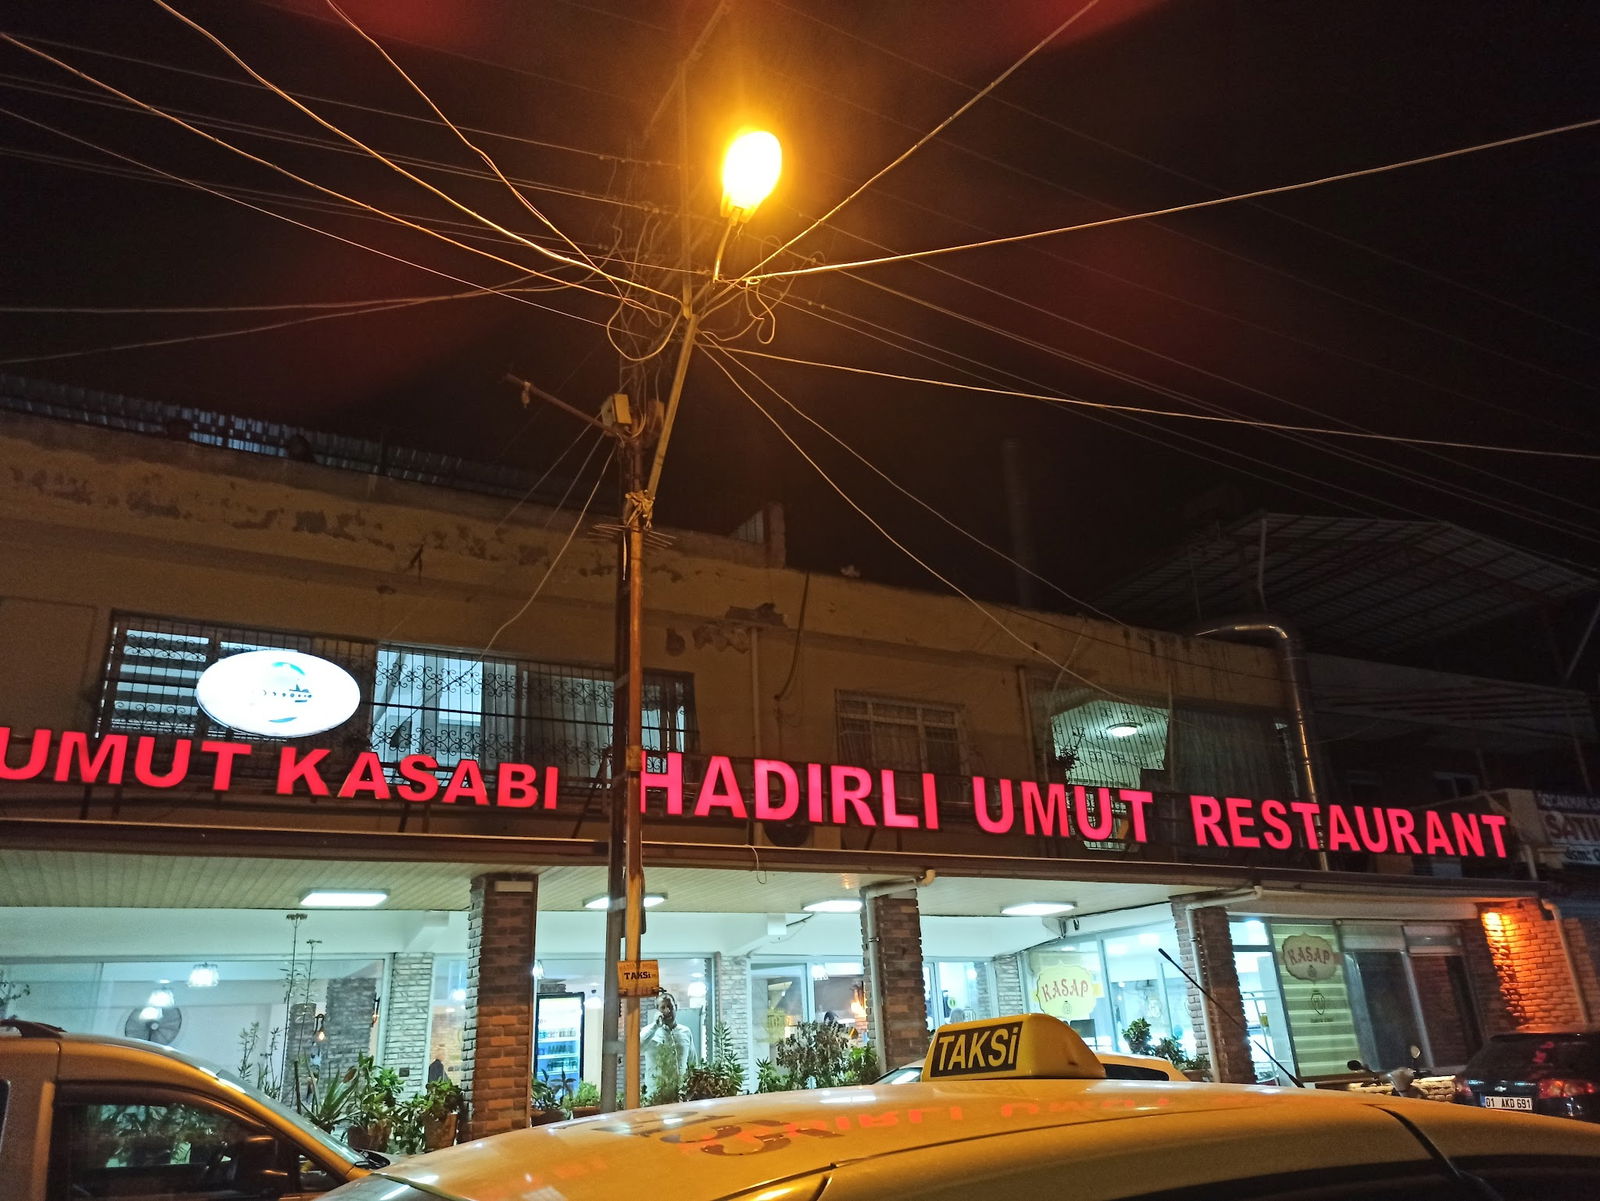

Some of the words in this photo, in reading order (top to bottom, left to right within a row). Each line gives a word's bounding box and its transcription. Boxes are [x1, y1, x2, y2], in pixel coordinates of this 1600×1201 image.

[0, 727, 252, 791] UMUT
[275, 746, 559, 810] KASABI
[640, 750, 939, 830] HADIRLI
[972, 776, 1153, 843] UMUT
[1190, 795, 1507, 858] RESTAURANT
[1287, 946, 1330, 966] KASAP
[1041, 978, 1089, 1002] KASAP
[1486, 1098, 1495, 1108] 01
[1517, 1099, 1531, 1109] 691
